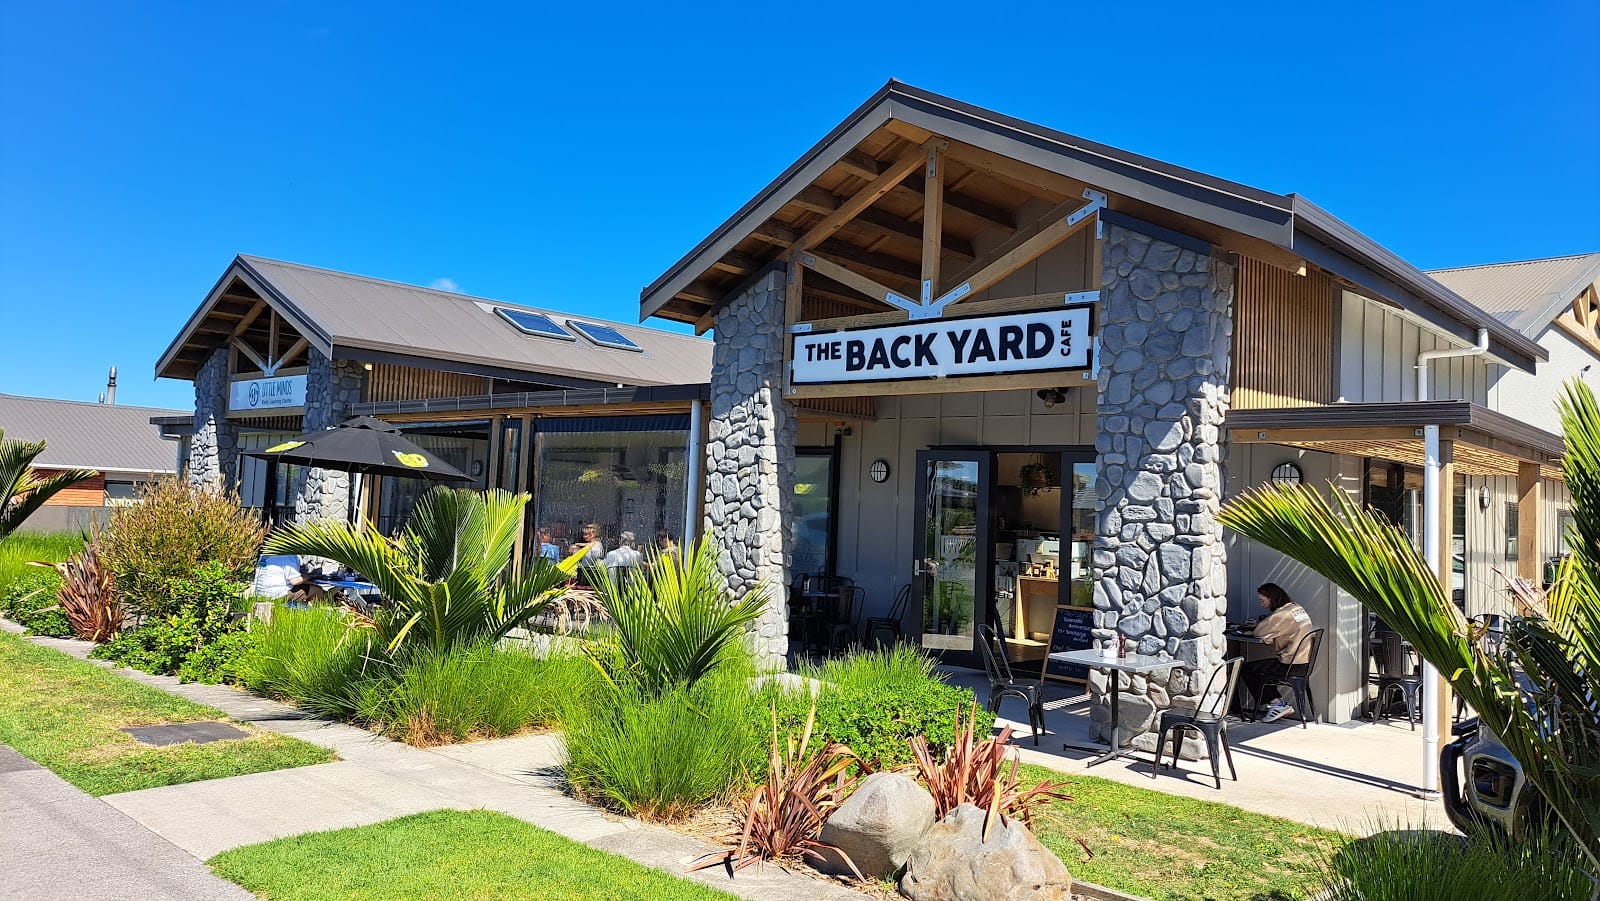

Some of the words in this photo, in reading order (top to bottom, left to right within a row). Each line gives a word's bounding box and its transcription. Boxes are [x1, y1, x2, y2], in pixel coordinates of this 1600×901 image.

[804, 341, 842, 362] THE
[846, 332, 938, 372] BACK
[946, 323, 1055, 364] YARD
[1060, 319, 1072, 357] CAFE
[261, 382, 276, 397] LITTLE
[277, 380, 292, 395] MINDS
